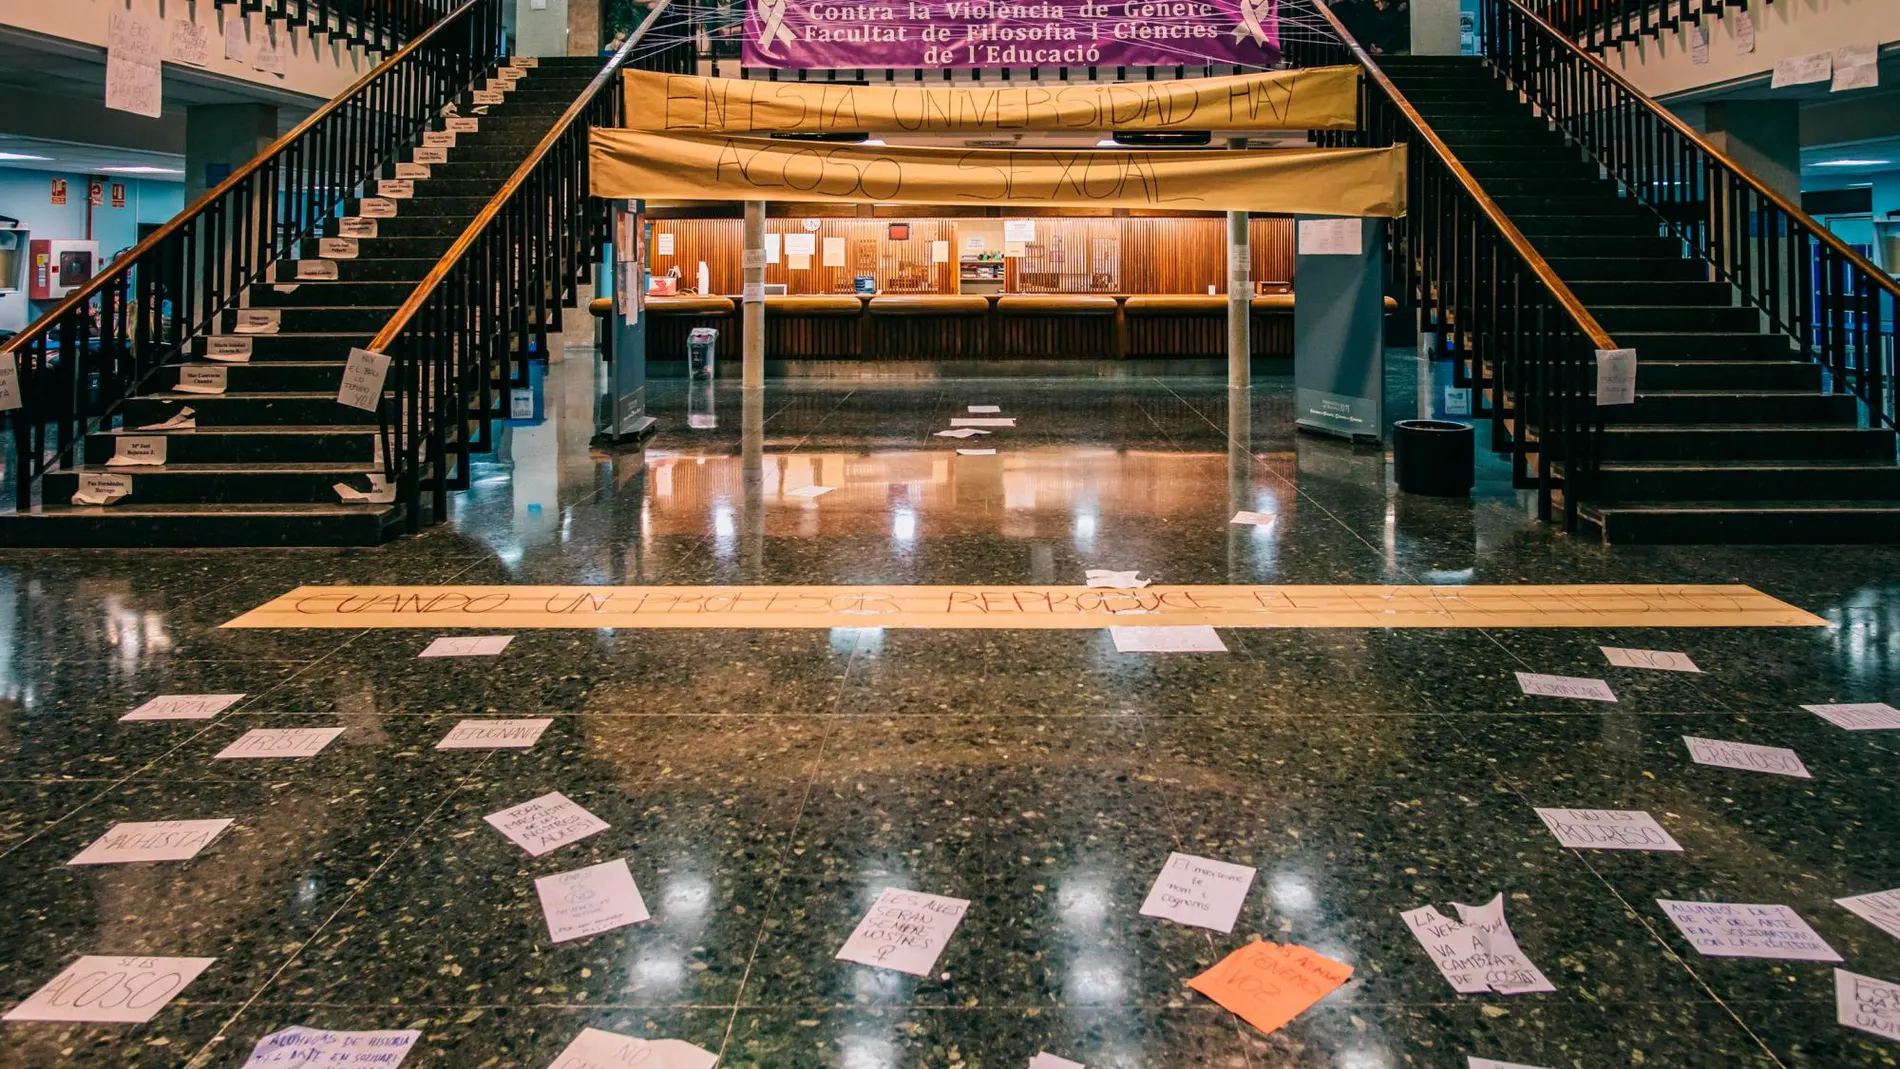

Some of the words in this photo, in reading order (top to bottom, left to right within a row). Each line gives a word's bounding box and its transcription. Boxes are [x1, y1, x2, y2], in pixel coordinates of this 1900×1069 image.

[809, 2, 895, 21] Contra
[908, 1, 931, 20] la
[946, 0, 1064, 19] Violència
[1079, 0, 1109, 18] de
[804, 24, 908, 43] Facultat
[921, 23, 952, 42] de
[966, 23, 1077, 42] Filosofia
[1091, 22, 1100, 40] i
[1113, 20, 1219, 40] Ciències
[924, 45, 954, 64] de
[665, 75, 730, 130] EN
[750, 81, 860, 131] ESTA
[1229, 76, 1296, 125] HAY
[716, 137, 902, 200] ACOSO
[956, 151, 1205, 203] SEXUAL
[295, 592, 513, 614] CUANDO
[545, 592, 619, 614] UN
[631, 591, 903, 614] PROFESOR
[946, 590, 1222, 614] REPRODUCE
[1252, 589, 1318, 609] EL
[1625, 650, 1676, 668] NO
[236, 733, 329, 751] TRISTE
[1694, 744, 1801, 772] GRACIOSO
[1569, 809, 1598, 821] NO
[1609, 811, 1632, 821] ES
[521, 813, 581, 840] NOSTRES
[1544, 809, 1667, 846] PROGRESO
[1171, 858, 1191, 871] El
[1168, 882, 1192, 894] nom
[1192, 876, 1204, 885] te
[881, 892, 919, 906] LES
[1160, 893, 1211, 912] cognoms
[877, 905, 934, 924] SERAN
[1413, 911, 1436, 927] LA
[1677, 914, 1697, 923] DE
[1758, 919, 1797, 929] ARTE
[868, 916, 937, 938] SEMPRE
[1686, 926, 1713, 936] EN
[862, 929, 934, 950] NOSTRES
[1433, 943, 1457, 958] VA
[1471, 935, 1484, 951] A
[1695, 937, 1725, 947] CON
[1728, 938, 1759, 948] LAS
[138, 957, 157, 968] ES
[1441, 952, 1523, 973] CAMBIAR
[1452, 973, 1474, 985] DE
[1485, 969, 1537, 985] COSTAT
[37, 971, 182, 1009] ACOSO
[613, 1043, 653, 1067] NO
